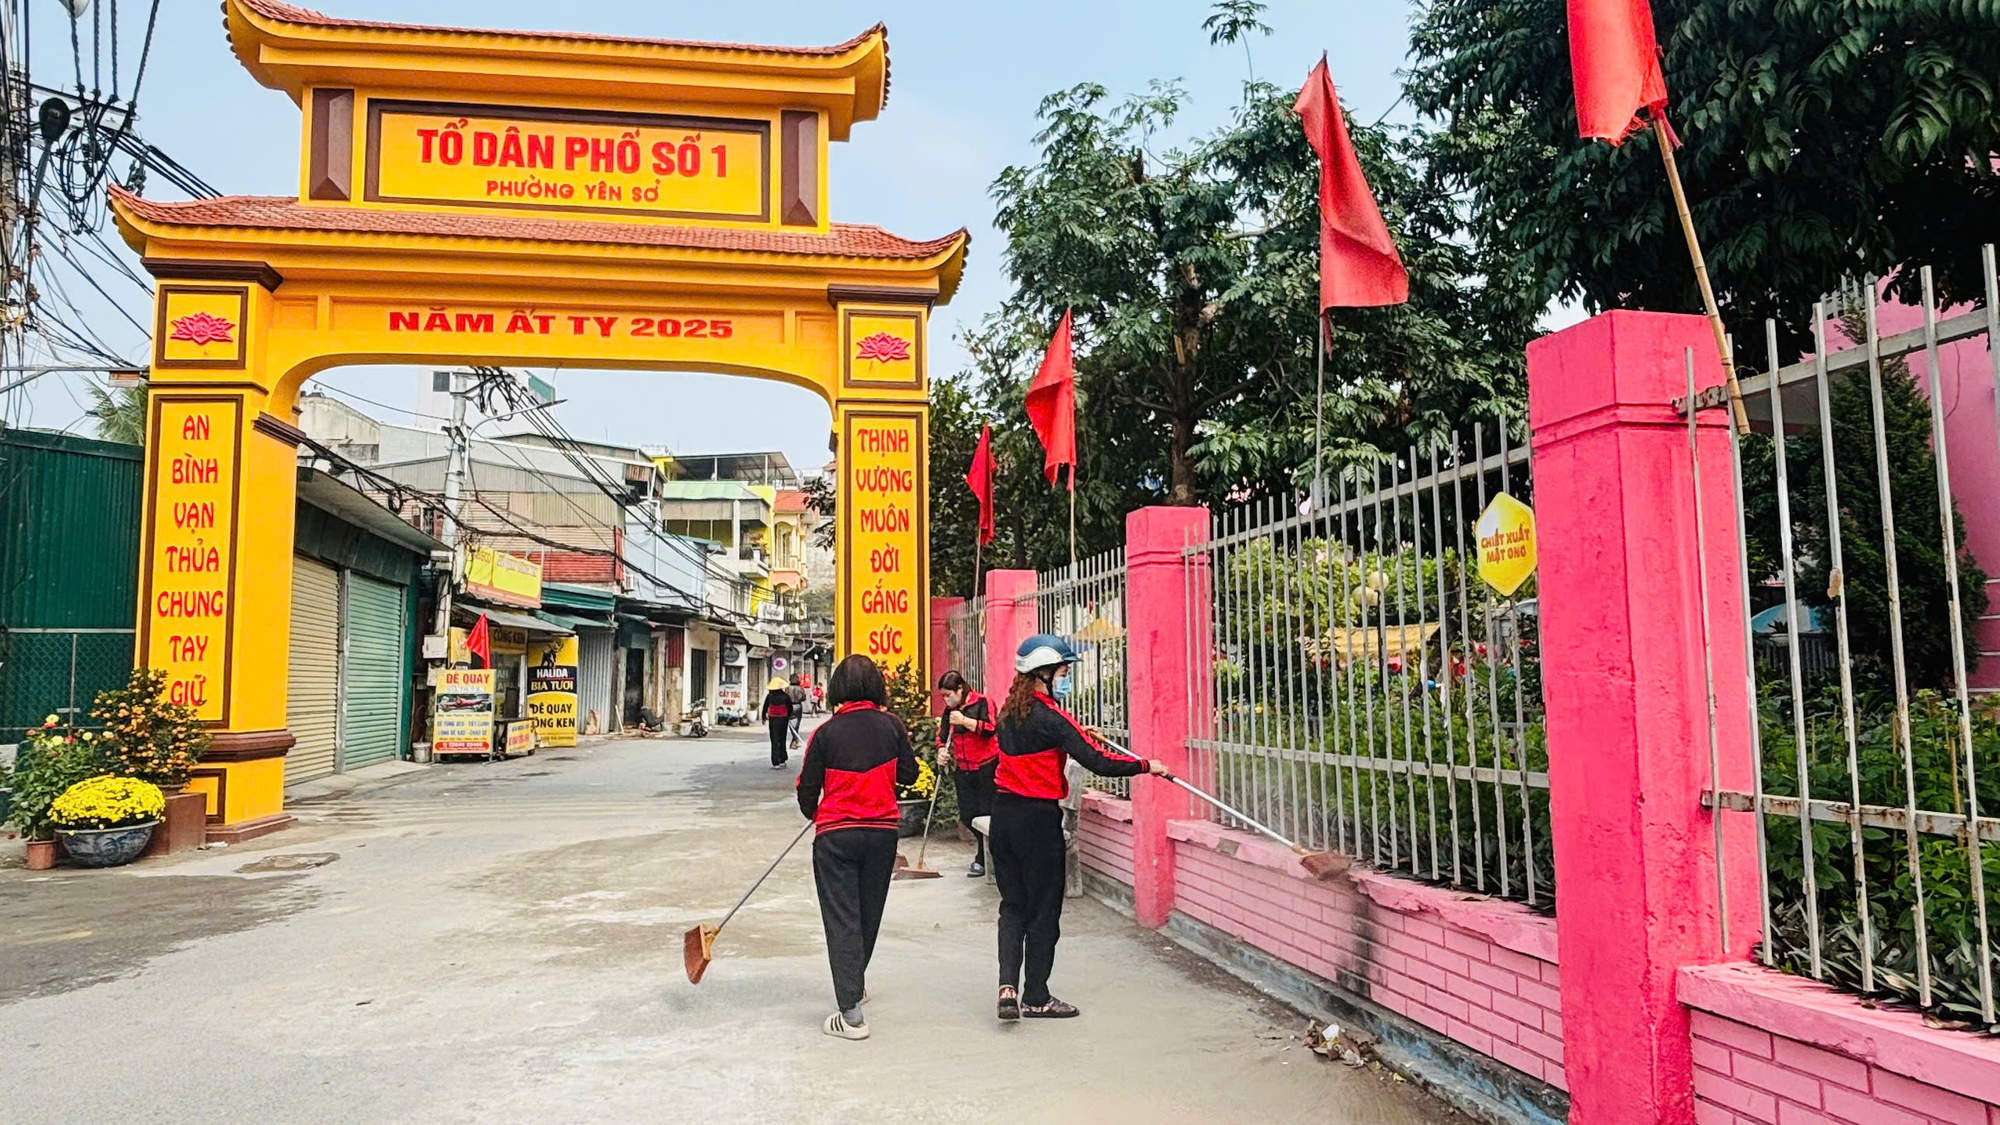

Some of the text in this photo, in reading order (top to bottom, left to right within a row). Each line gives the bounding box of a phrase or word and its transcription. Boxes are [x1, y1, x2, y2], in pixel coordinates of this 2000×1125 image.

[417, 118, 728, 178] TỔ DÂN PHỐ SỐ 1
[486, 174, 661, 203] PHƯỜNG YÊN SỞ
[389, 306, 494, 333] NĂM
[505, 308, 557, 335] ẤT
[630, 317, 733, 339] 2025
[183, 414, 210, 441] AN
[857, 428, 909, 457] THỊNH
[171, 451, 219, 485] BÌNH
[856, 466, 912, 498] VƯỢNG
[174, 501, 215, 535] VẠN
[860, 504, 909, 533] MUÔN
[1506, 523, 1530, 544] XUẤT
[165, 538, 220, 573] THỦA
[870, 544, 900, 573] ĐỜI
[1486, 545, 1526, 564] MẬT ONG
[157, 589, 224, 617] CHUNG
[862, 578, 908, 614] GẮNG
[169, 635, 209, 662] TAY
[869, 624, 903, 655] SỨC
[463, 673, 490, 685] QUAY
[531, 681, 548, 691] BIA
[536, 668, 568, 678] HALIDA
[170, 674, 206, 706] GIỮ
[546, 703, 572, 715] QUAY
[556, 717, 575, 728] KEN
